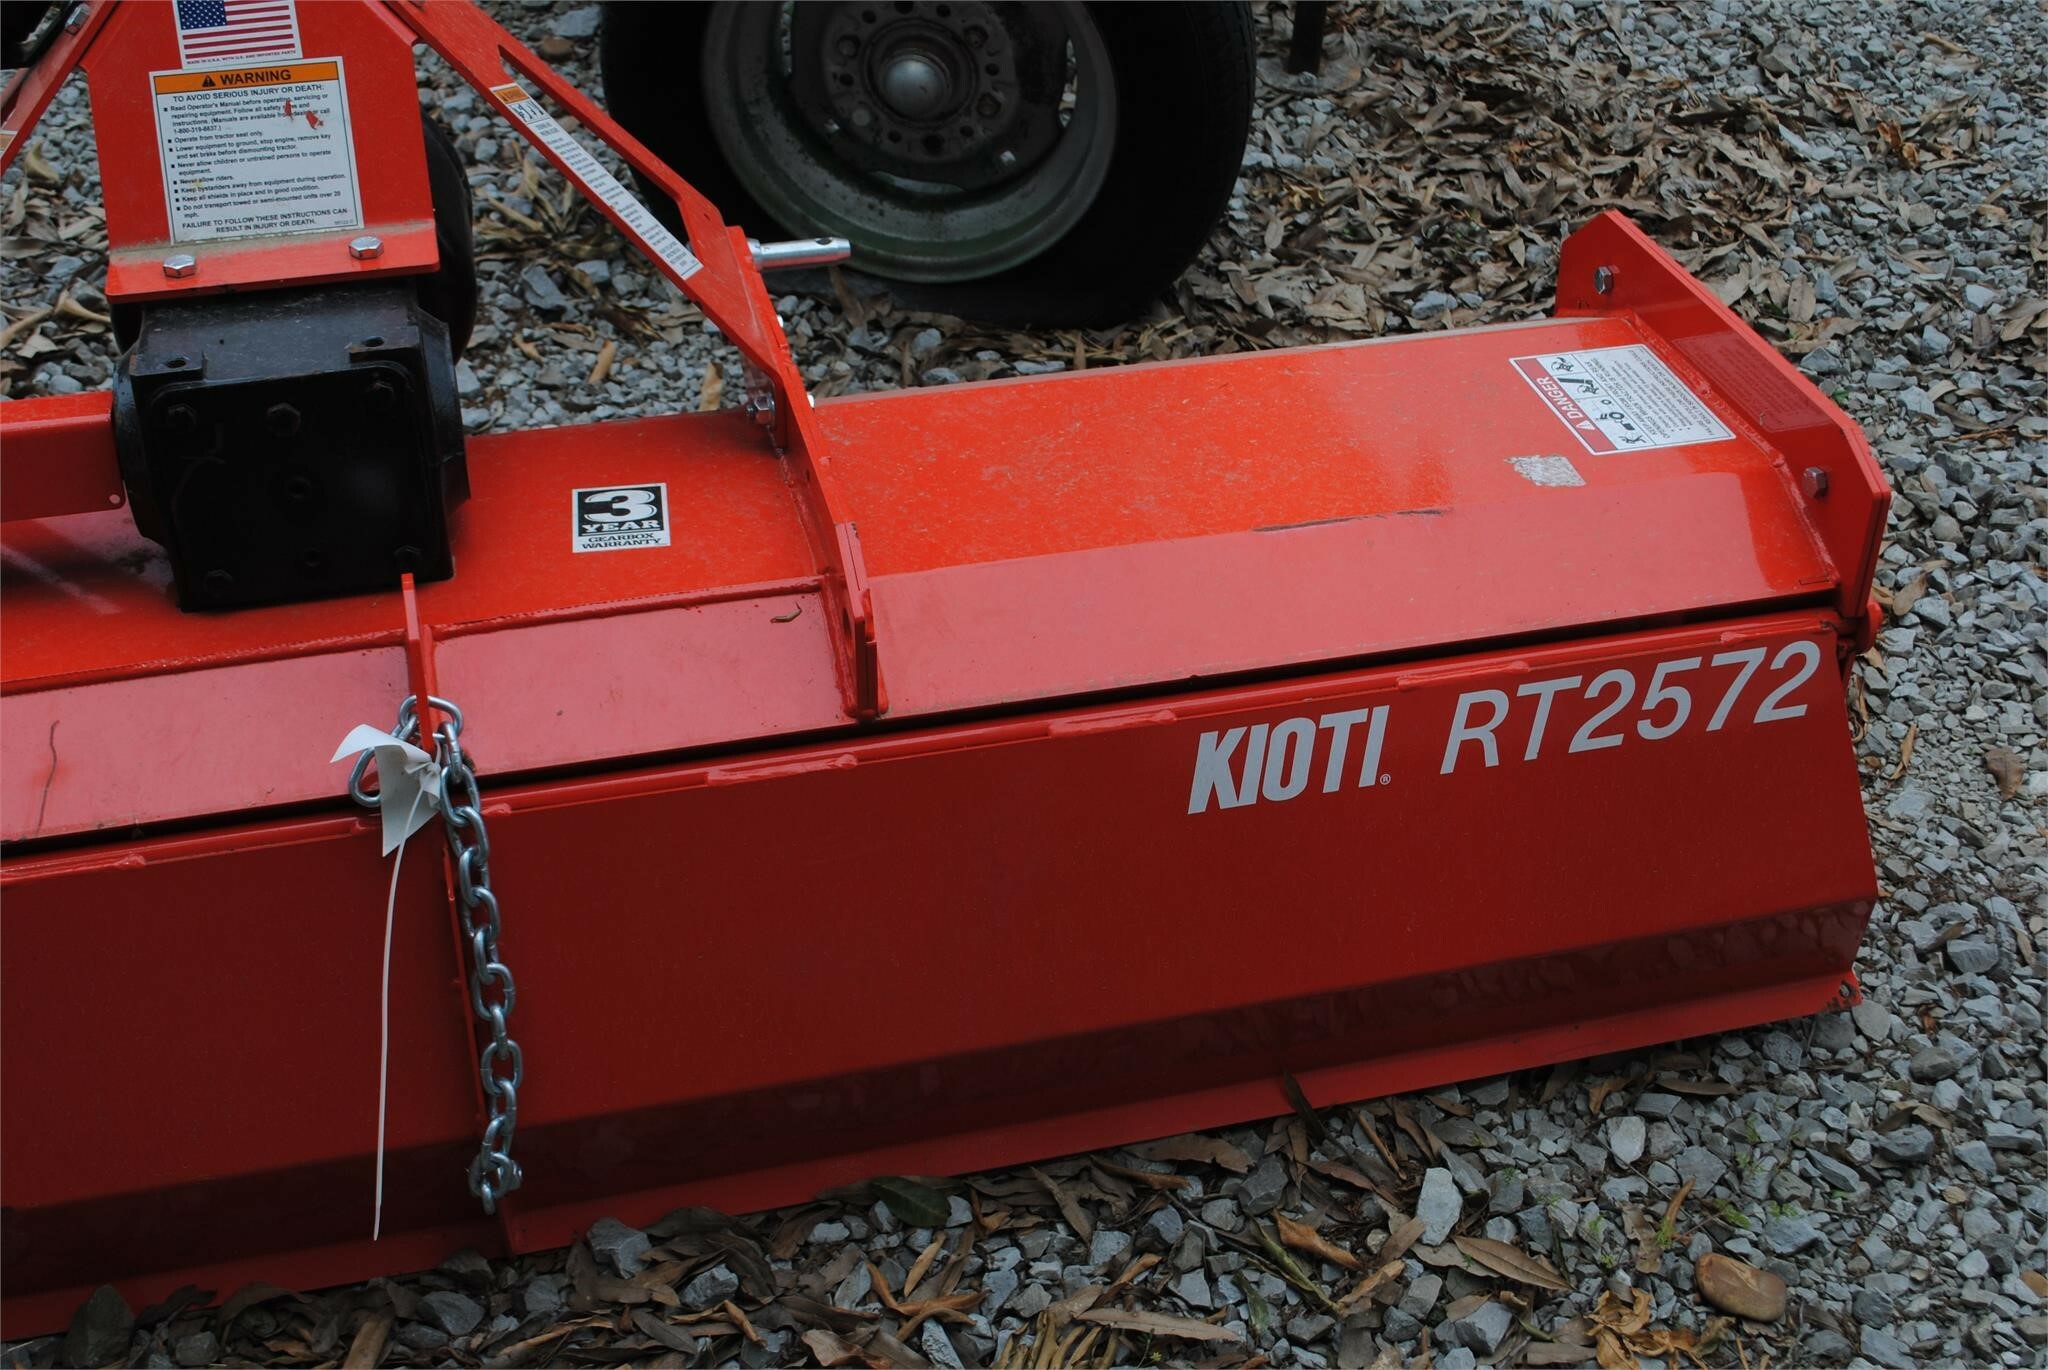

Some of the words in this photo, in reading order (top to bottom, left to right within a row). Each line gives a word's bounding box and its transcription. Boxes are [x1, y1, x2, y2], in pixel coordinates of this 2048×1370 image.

[220, 69, 291, 85] WARNING
[186, 93, 211, 101] AVOID
[213, 90, 248, 99] SERIOUS
[251, 88, 279, 96] INJURY
[198, 184, 230, 192] bystanders
[204, 201, 232, 209] transport
[183, 221, 211, 229] FAILURE
[225, 217, 254, 225] FOLLOW
[280, 210, 331, 219] INSTRUCTIONS
[1535, 376, 1583, 419] DANGER
[585, 490, 657, 522] 3
[582, 520, 660, 532] YEAR
[583, 538, 662, 549] WARRANTY
[589, 533, 654, 542] GEARBOX
[1440, 640, 1821, 775] RT2572
